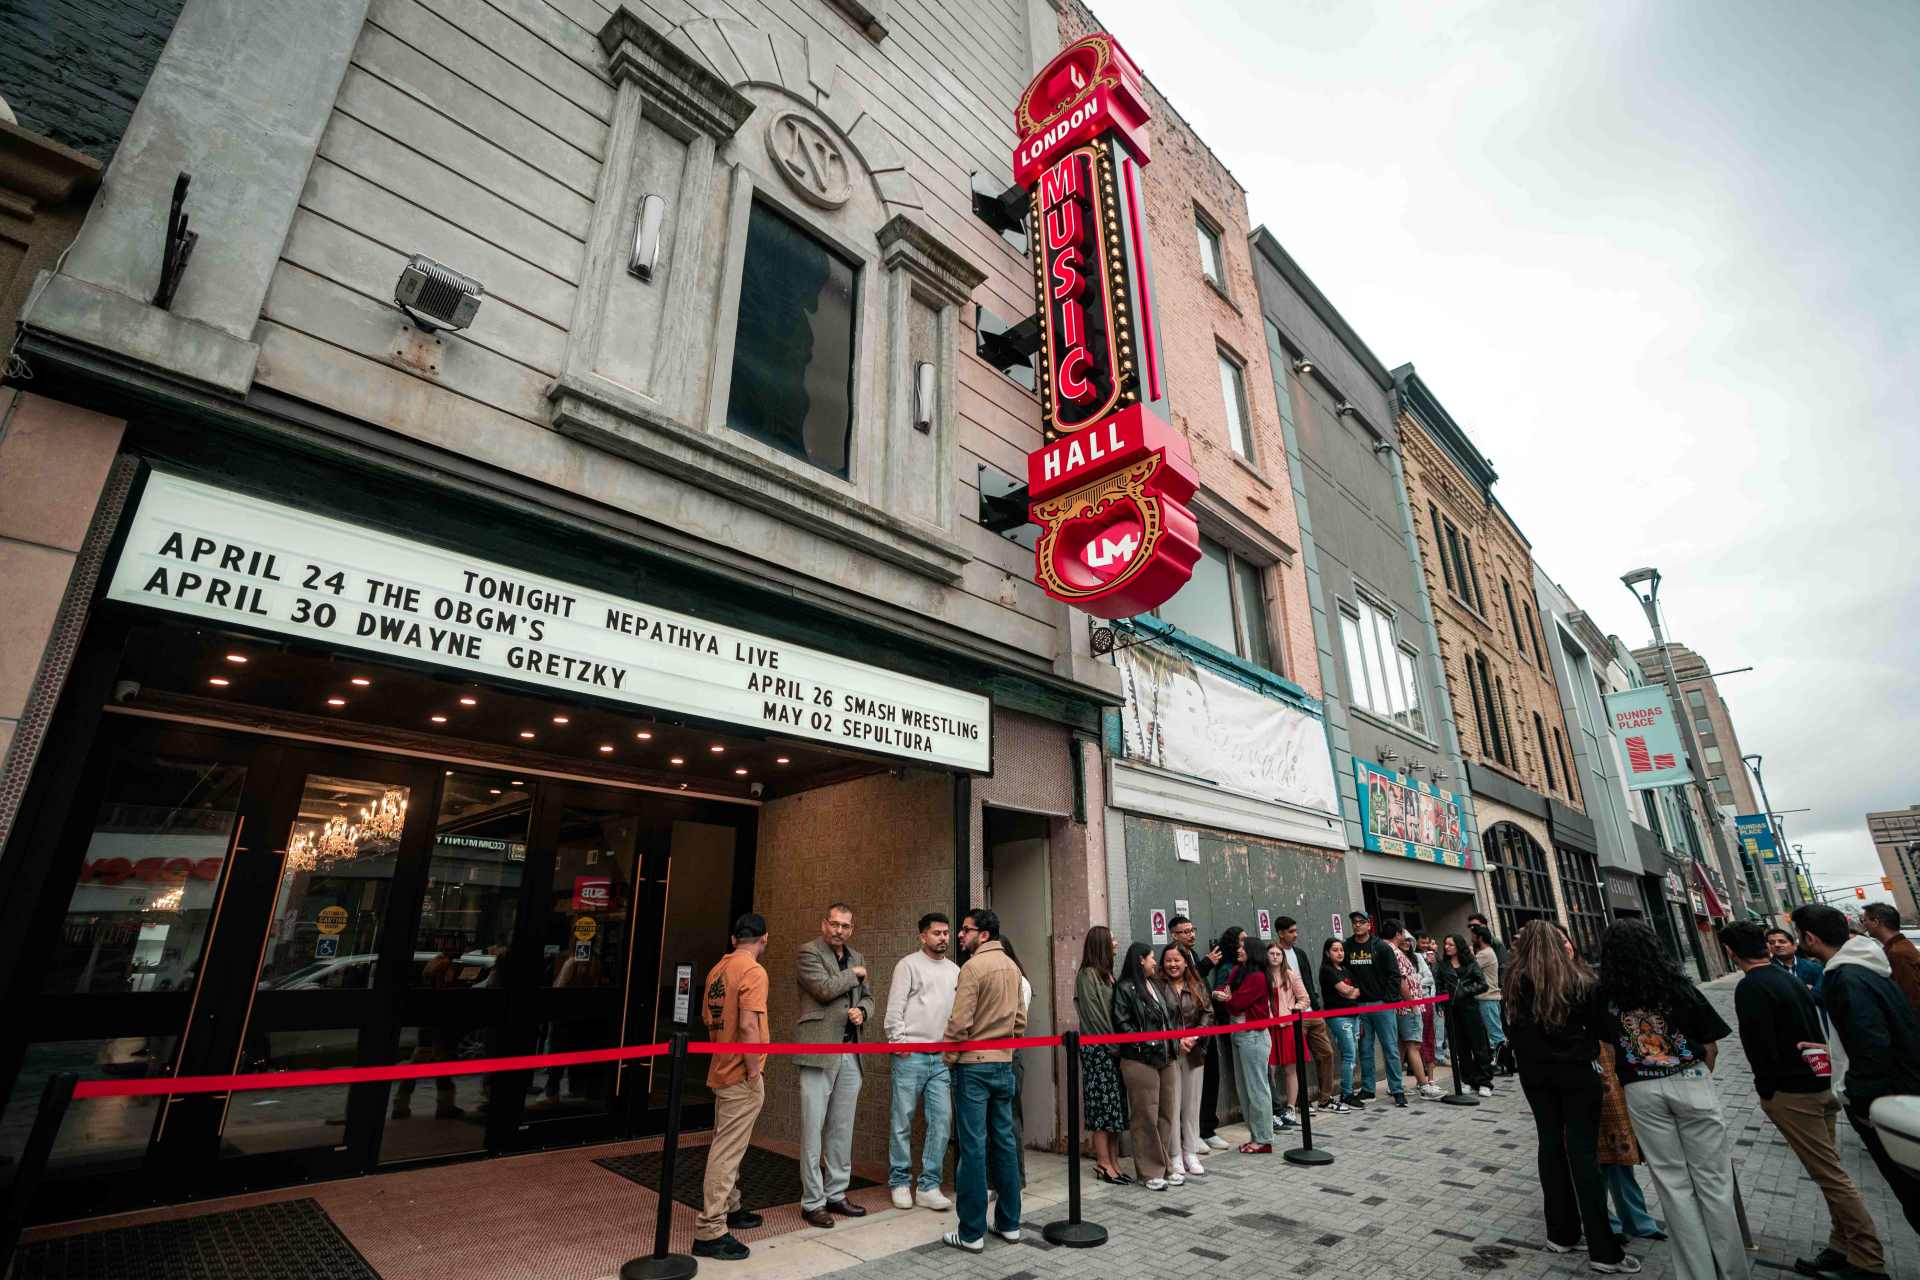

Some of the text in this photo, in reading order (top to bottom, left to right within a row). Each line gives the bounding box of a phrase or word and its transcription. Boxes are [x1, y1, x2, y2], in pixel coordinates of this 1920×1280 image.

[1021, 97, 1098, 167] LONDON
[1040, 152, 1088, 399] MUSIC
[1043, 422, 1125, 481] HALL
[158, 531, 546, 642] APRIL 24 THE OBGM'S
[463, 570, 779, 670] TONIGHT NEPATHYA LIVE
[143, 566, 627, 690] APRIL 30 DWAYNE GRETZKY
[747, 672, 979, 740] APRIL 26 SMASH WRESTLING
[763, 701, 933, 753] MAY 02 SEPULTURA
[1616, 706, 1664, 722] DUNDAS
[1618, 717, 1656, 730] PLACE
